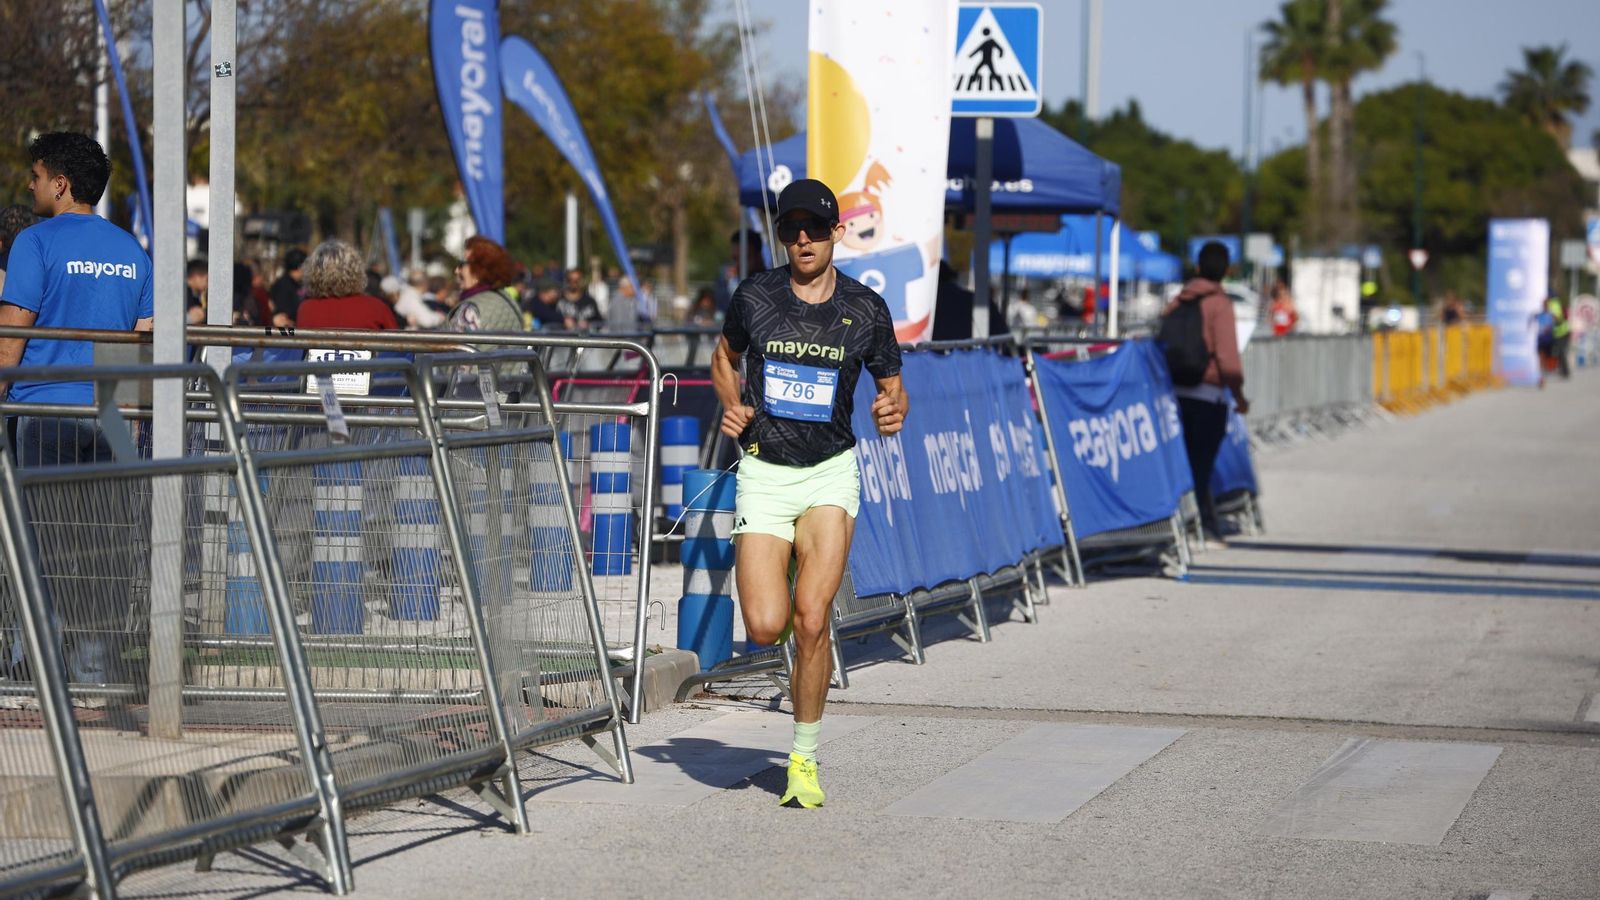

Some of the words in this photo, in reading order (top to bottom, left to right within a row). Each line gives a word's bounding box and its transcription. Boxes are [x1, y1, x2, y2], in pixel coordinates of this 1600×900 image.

[455, 5, 493, 182] mayoral
[66, 261, 137, 280] mayoral
[766, 340, 845, 362] mayoral
[782, 381, 815, 400] 796
